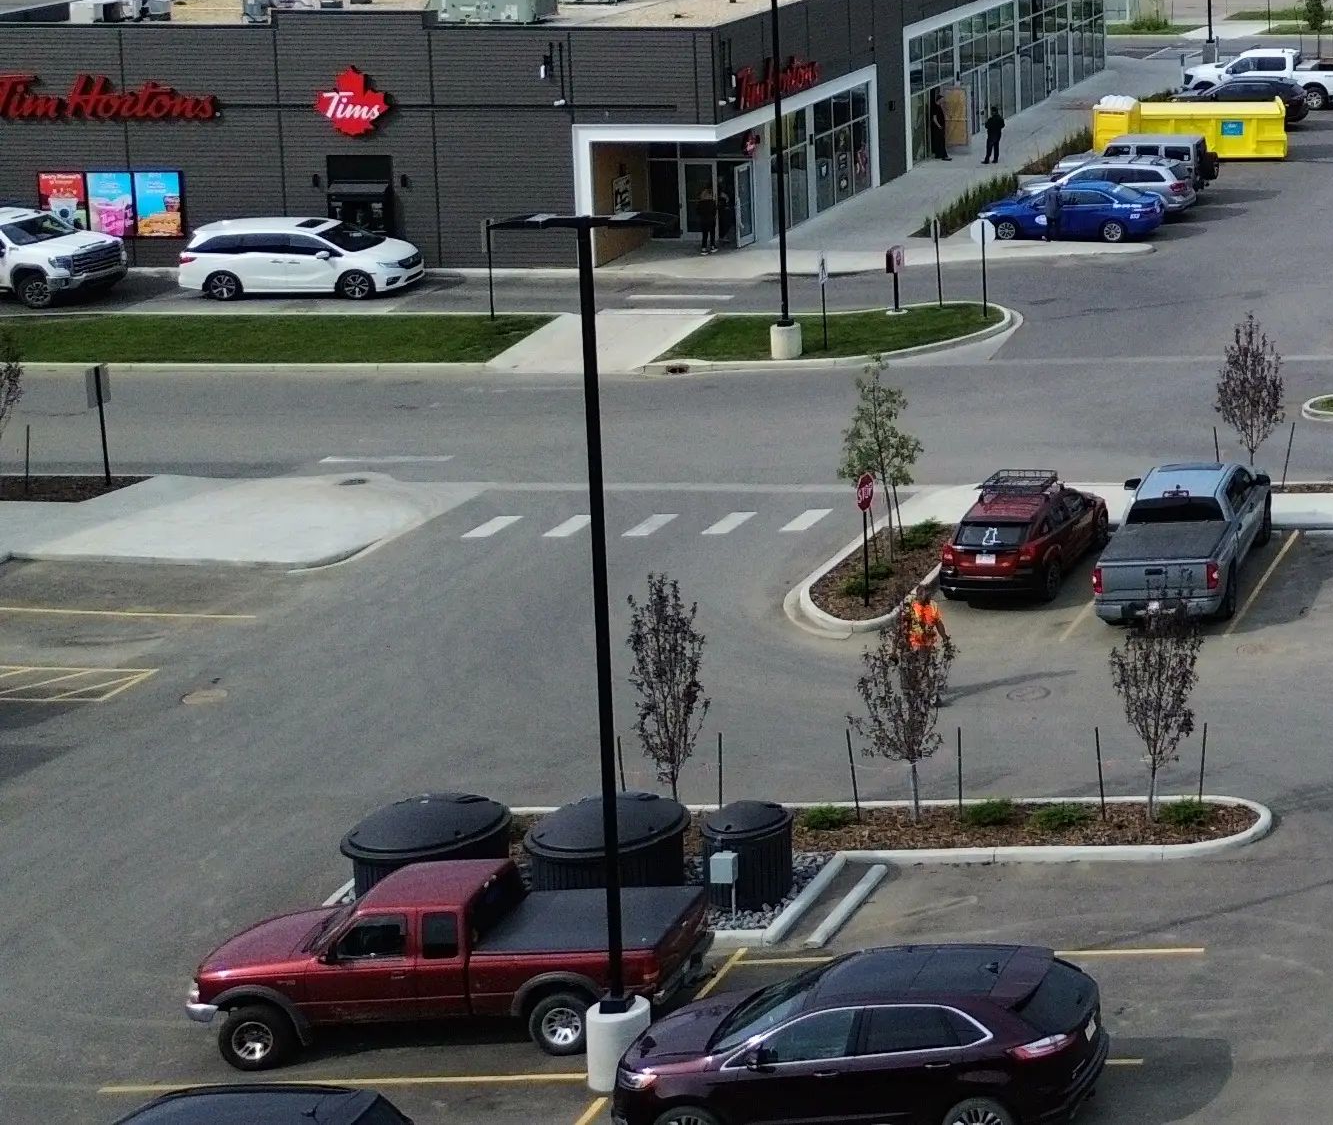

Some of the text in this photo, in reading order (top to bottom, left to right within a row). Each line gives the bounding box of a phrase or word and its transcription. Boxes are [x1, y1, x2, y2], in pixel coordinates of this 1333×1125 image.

[0, 74, 217, 118] Tim Hortons
[322, 91, 380, 119] Tims
